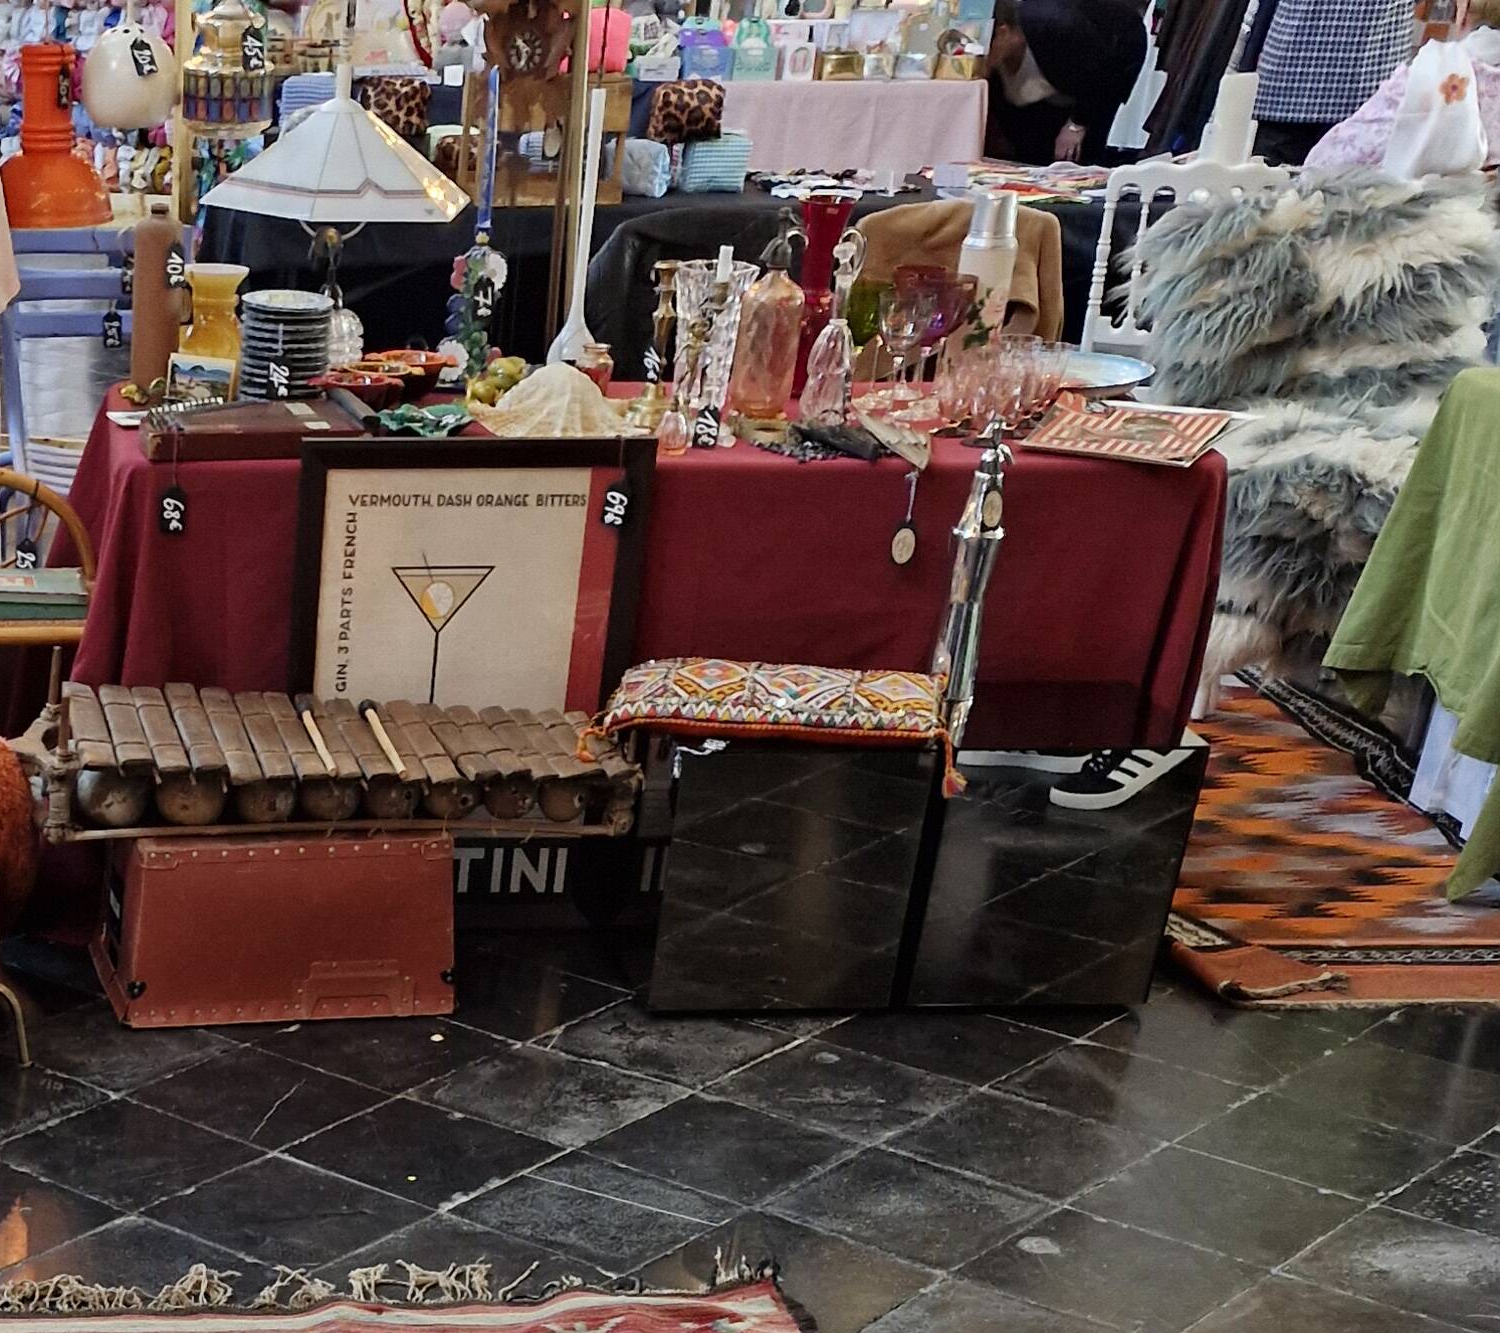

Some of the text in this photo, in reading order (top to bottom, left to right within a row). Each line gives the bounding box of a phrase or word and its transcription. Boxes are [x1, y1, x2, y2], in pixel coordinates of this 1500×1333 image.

[162, 497, 186, 532] 68€
[437, 493, 472, 508] DASH
[476, 493, 530, 508] ORANGE
[536, 493, 588, 508] BITTERS
[343, 511, 358, 579] FRENCH
[338, 586, 353, 641] PARTS
